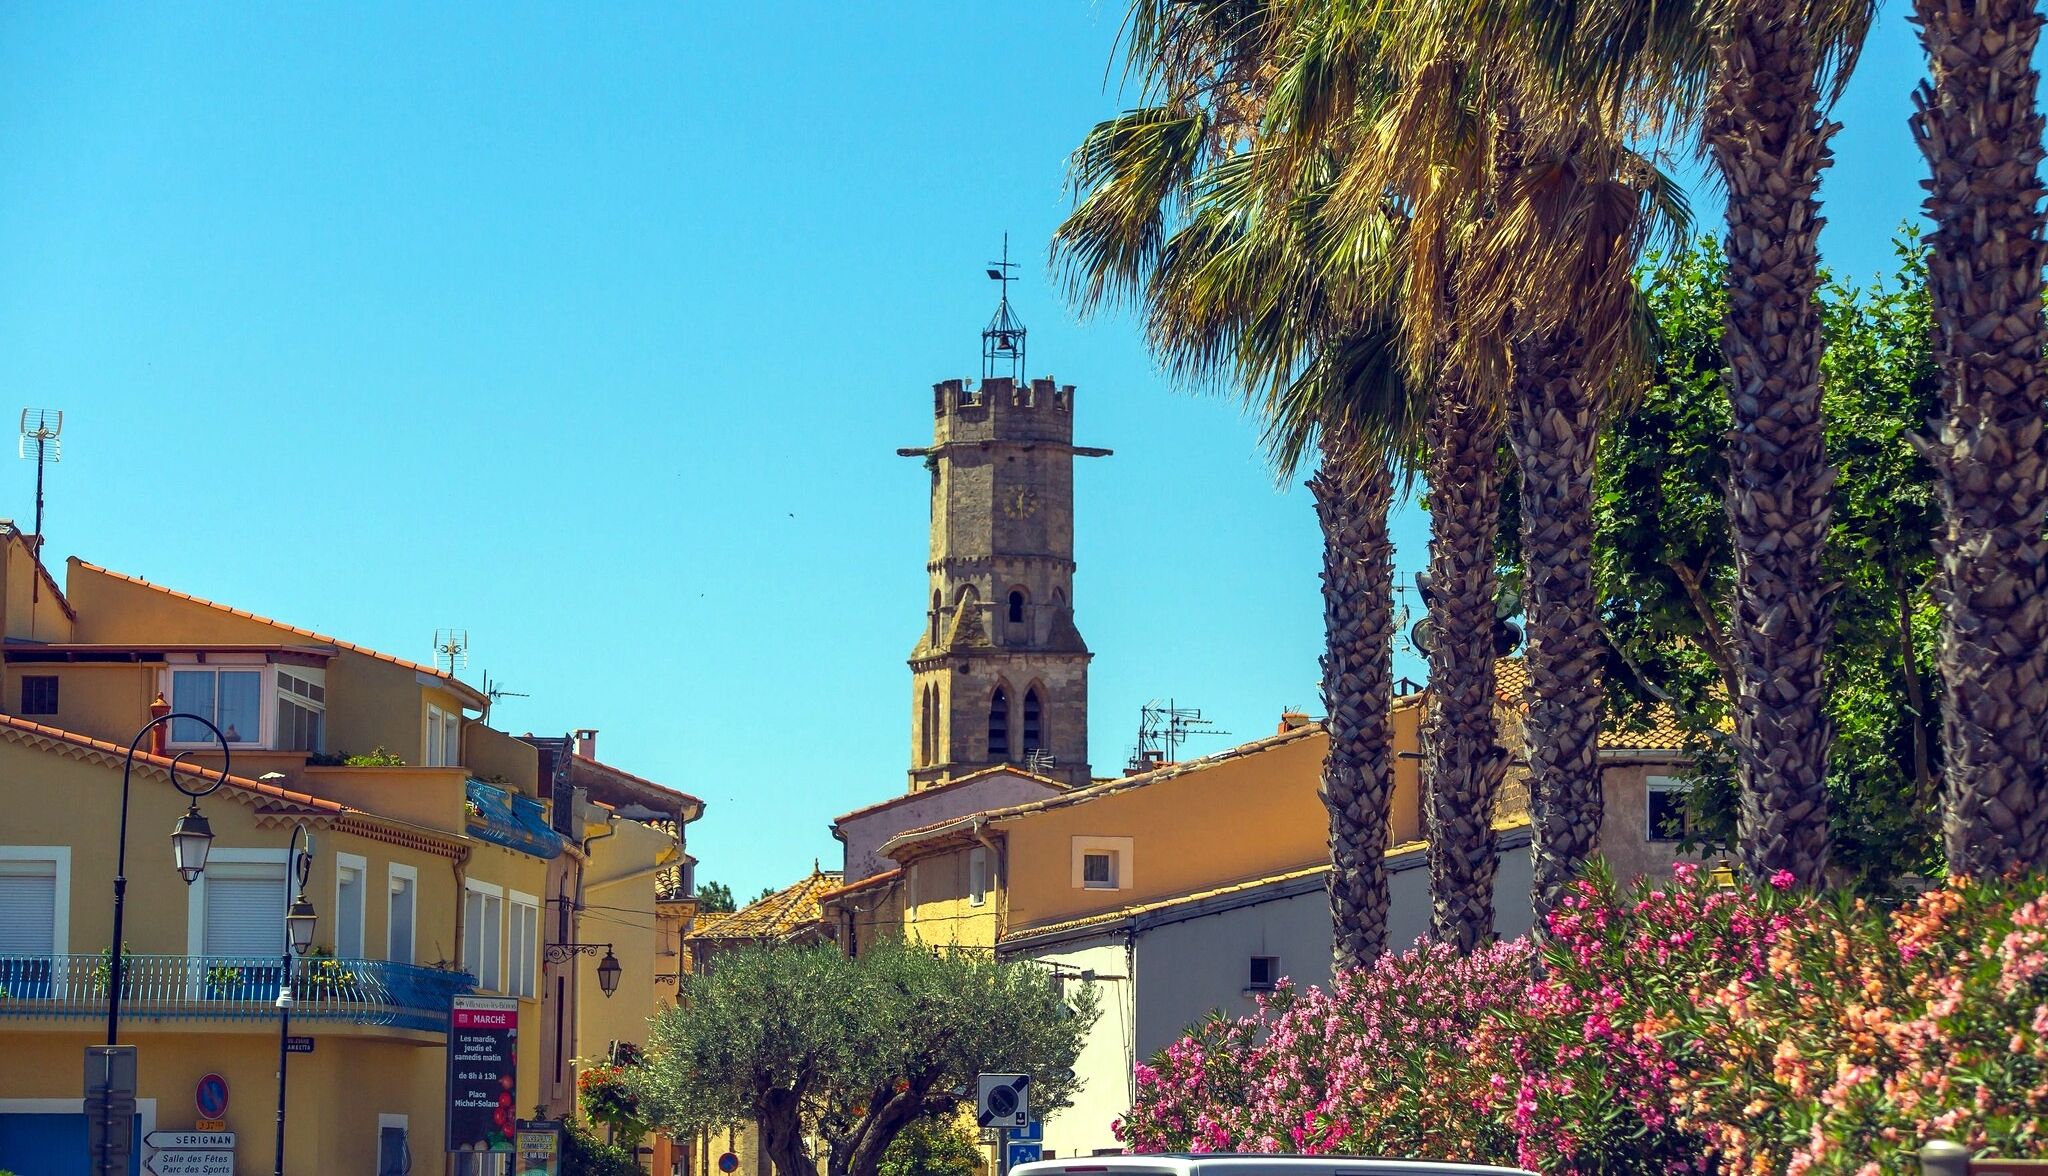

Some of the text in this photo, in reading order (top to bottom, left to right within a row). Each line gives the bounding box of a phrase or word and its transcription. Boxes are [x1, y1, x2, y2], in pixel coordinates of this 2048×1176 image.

[473, 1013, 506, 1024] MARCHÉ
[460, 1034, 497, 1044] Les mardis,
[464, 1044, 484, 1053] jeudis
[454, 1053, 502, 1062] samedis matin
[458, 1072, 467, 1080] de
[468, 1072, 477, 1080] 8h
[484, 1072, 497, 1080] 13h
[468, 1090, 487, 1098] Place
[454, 1099, 500, 1108] Michel-Solans
[162, 1154, 228, 1163] Salle des Fêtes
[162, 1165, 230, 1175] Parc des Sports
